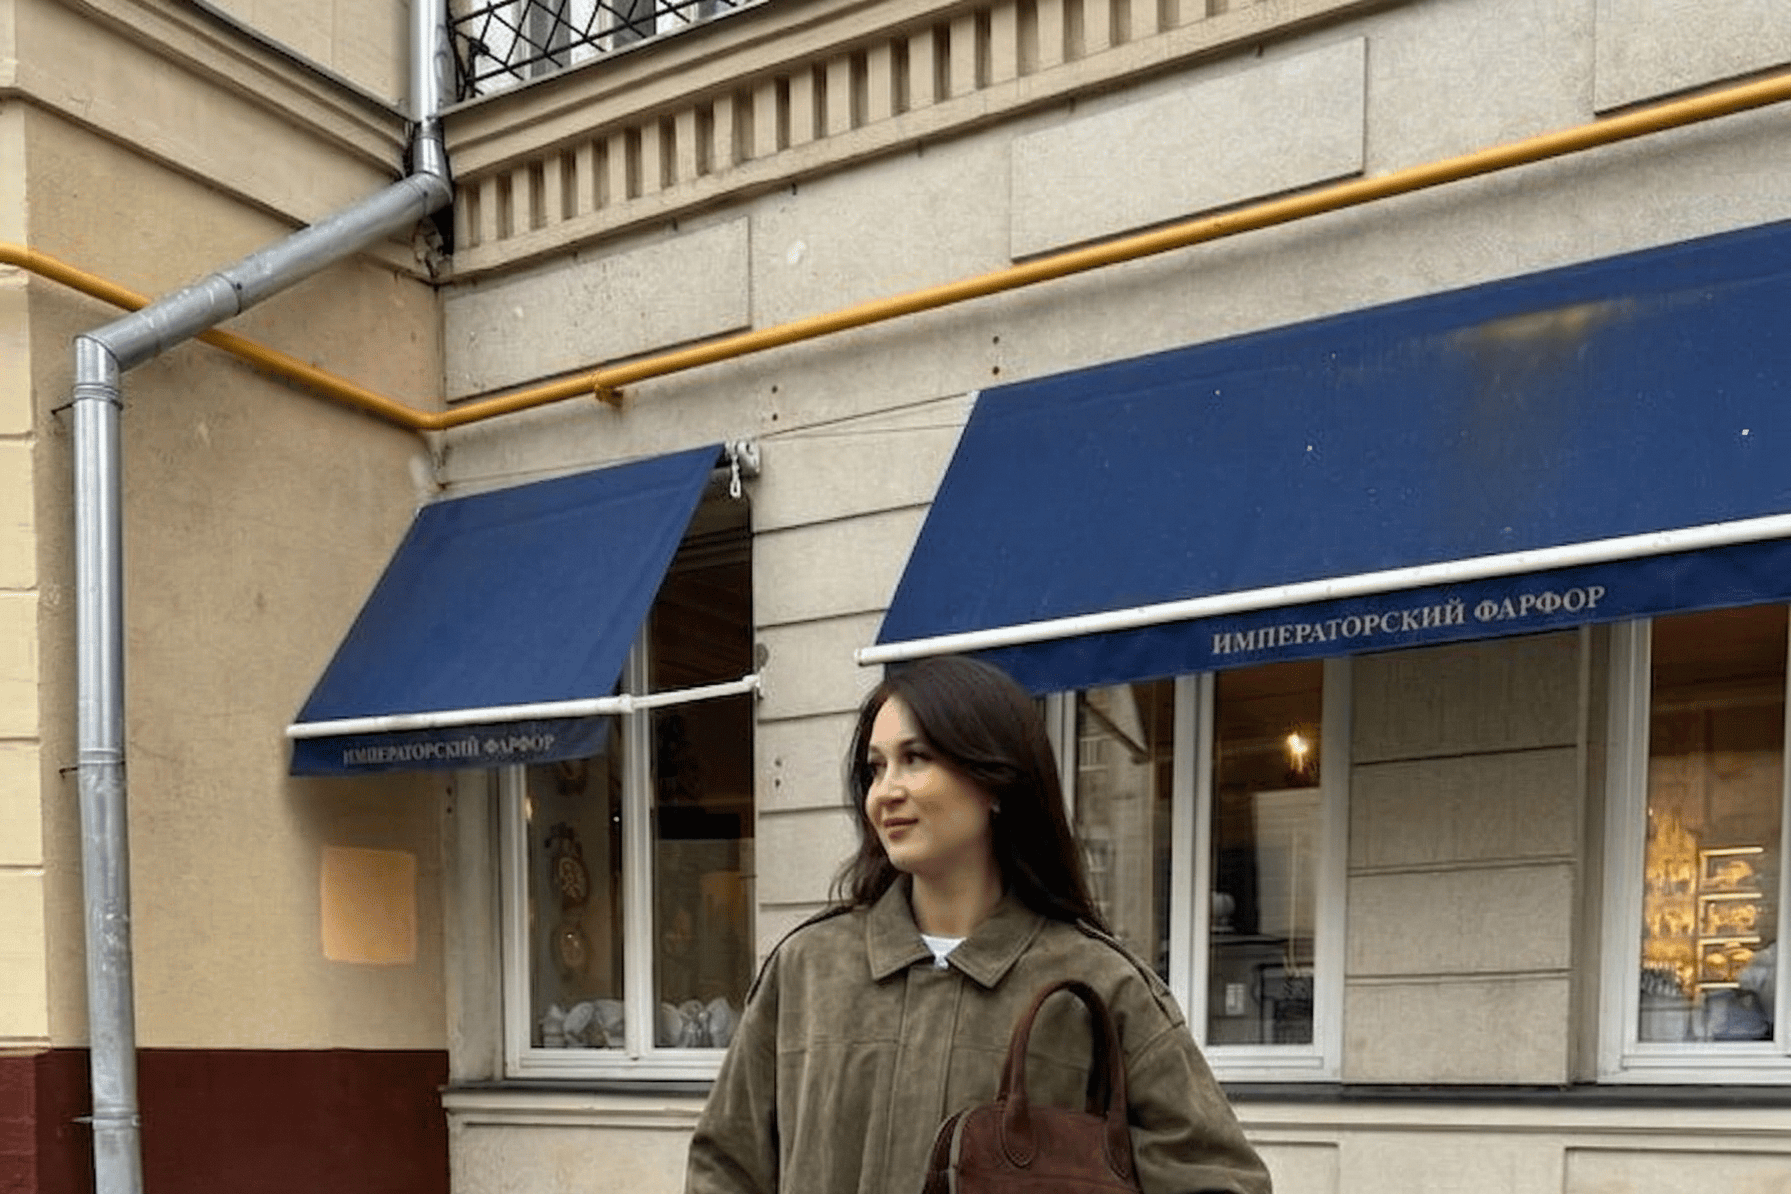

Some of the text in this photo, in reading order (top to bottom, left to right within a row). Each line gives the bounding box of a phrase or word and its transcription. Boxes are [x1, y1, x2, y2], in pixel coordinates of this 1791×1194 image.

[1212, 585, 1606, 655] ИМПЕРАТОРСКИЙ ФАРФОР
[343, 735, 479, 765] ИМПЕРАТОРСКИЙ
